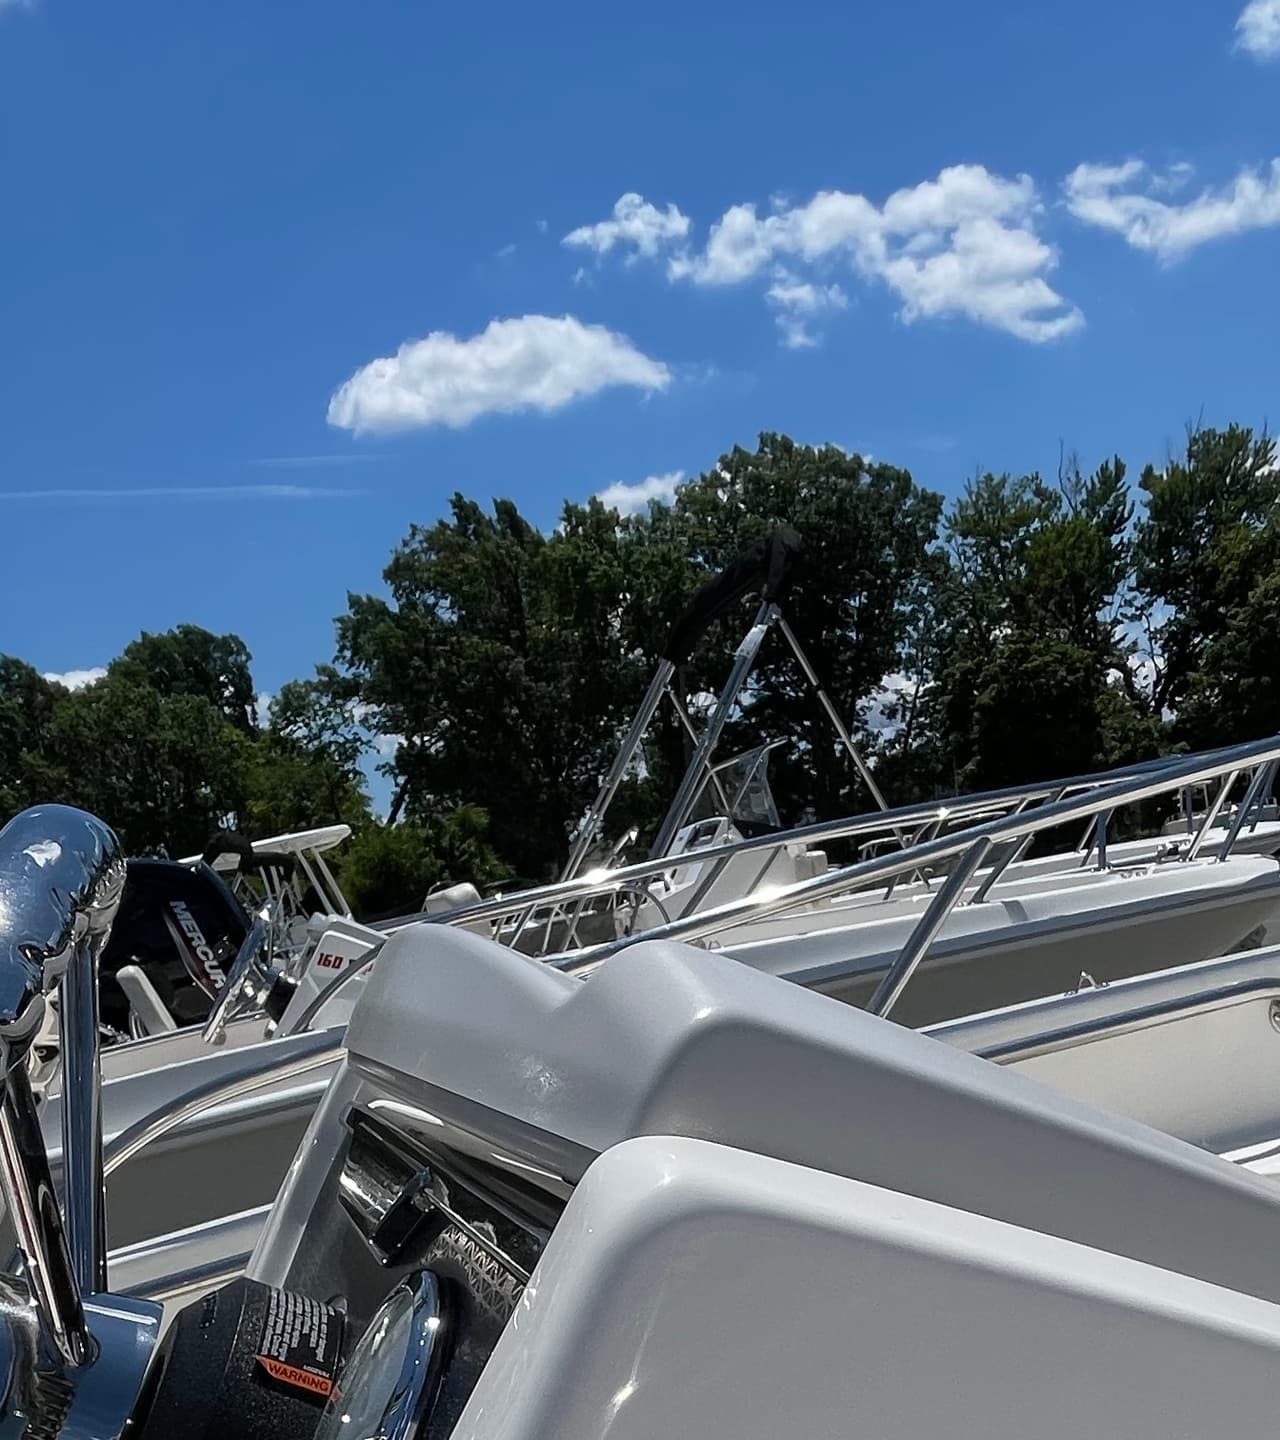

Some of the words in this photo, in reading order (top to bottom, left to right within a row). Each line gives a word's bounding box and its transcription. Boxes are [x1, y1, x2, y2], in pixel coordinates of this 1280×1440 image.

[169, 900, 227, 989] MERCUR
[317, 953, 344, 969] 160
[268, 1363, 329, 1392] WARNING
